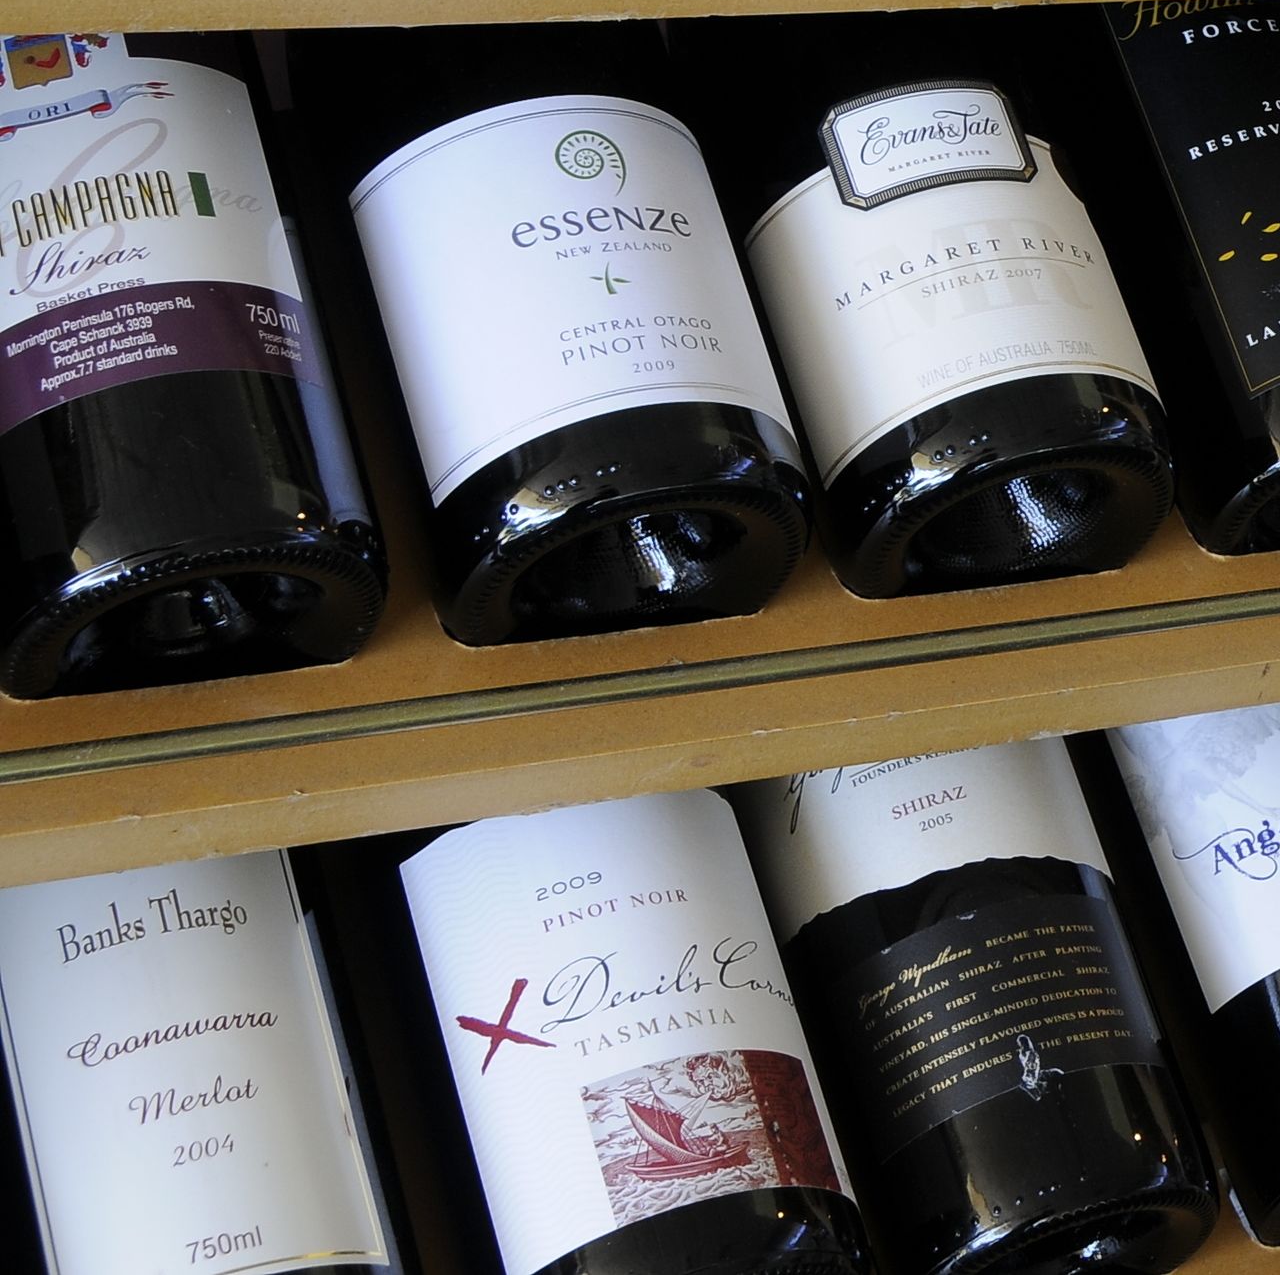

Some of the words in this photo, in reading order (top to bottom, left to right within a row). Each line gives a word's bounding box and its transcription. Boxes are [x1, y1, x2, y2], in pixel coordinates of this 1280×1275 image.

[1181, 18, 1280, 45] FORCE
[11, 169, 180, 249] CAMPAGNA
[9, 241, 151, 295] Shiraz
[555, 245, 592, 261] NEW
[601, 241, 672, 253] ZEALAND
[834, 238, 1002, 311] MARGARET
[1022, 237, 1096, 266] RIVER
[921, 268, 1001, 299] SHIRAZ
[1005, 267, 1043, 281] 2007
[36, 291, 93, 314] Basket
[98, 277, 146, 294] Press
[50, 338, 79, 355] Cape
[79, 324, 125, 343] Schanck
[125, 315, 153, 331] 3939
[62, 310, 114, 334] Peninsula
[114, 304, 135, 319] 176
[136, 299, 174, 315] Rogers
[559, 317, 646, 343] CENTRAL
[653, 316, 712, 331] OTAGO
[53, 346, 97, 369] Product
[109, 331, 156, 349] Australia
[95, 348, 142, 372] standard
[143, 343, 179, 360] drinks
[561, 334, 647, 366] PINOT
[661, 333, 723, 354] NOIR
[632, 359, 676, 374] 2009
[891, 786, 967, 820] SHIRAZ
[919, 813, 953, 832] 2005
[534, 870, 603, 901] 2009
[56, 901, 145, 965] Banks
[148, 888, 248, 935] Thargo
[541, 898, 619, 933] PINOT
[629, 888, 688, 907] NOIR
[898, 945, 972, 987] Wyndham
[985, 931, 1030, 948] BECAME
[1035, 927, 1057, 935] THE
[539, 943, 712, 1034] Devil's
[884, 978, 950, 1019] AUSTRALIAN
[958, 960, 1003, 981] SHIRAZ
[1012, 950, 1047, 964] AFTER
[945, 992, 978, 1011] FIRST
[991, 969, 1065, 993] COMMERCIAL
[574, 1007, 736, 1057] TASMANIA
[930, 1028, 949, 1043] HIS
[951, 997, 1039, 1034] SINGLE-MINDED
[1041, 987, 1103, 1003] DEDICATION
[66, 1010, 279, 1069] Coonawarra
[920, 1042, 976, 1075] INTENSELY
[979, 1019, 1042, 1046] FLAVOURED
[1043, 1011, 1076, 1024] WINES
[930, 1074, 958, 1095] THAT
[962, 1052, 1013, 1078] ENDURES
[1066, 1030, 1110, 1044] PRESENT
[128, 1075, 260, 1125] Merlot
[172, 1133, 236, 1167] 2004
[185, 1226, 264, 1265] 750ml
